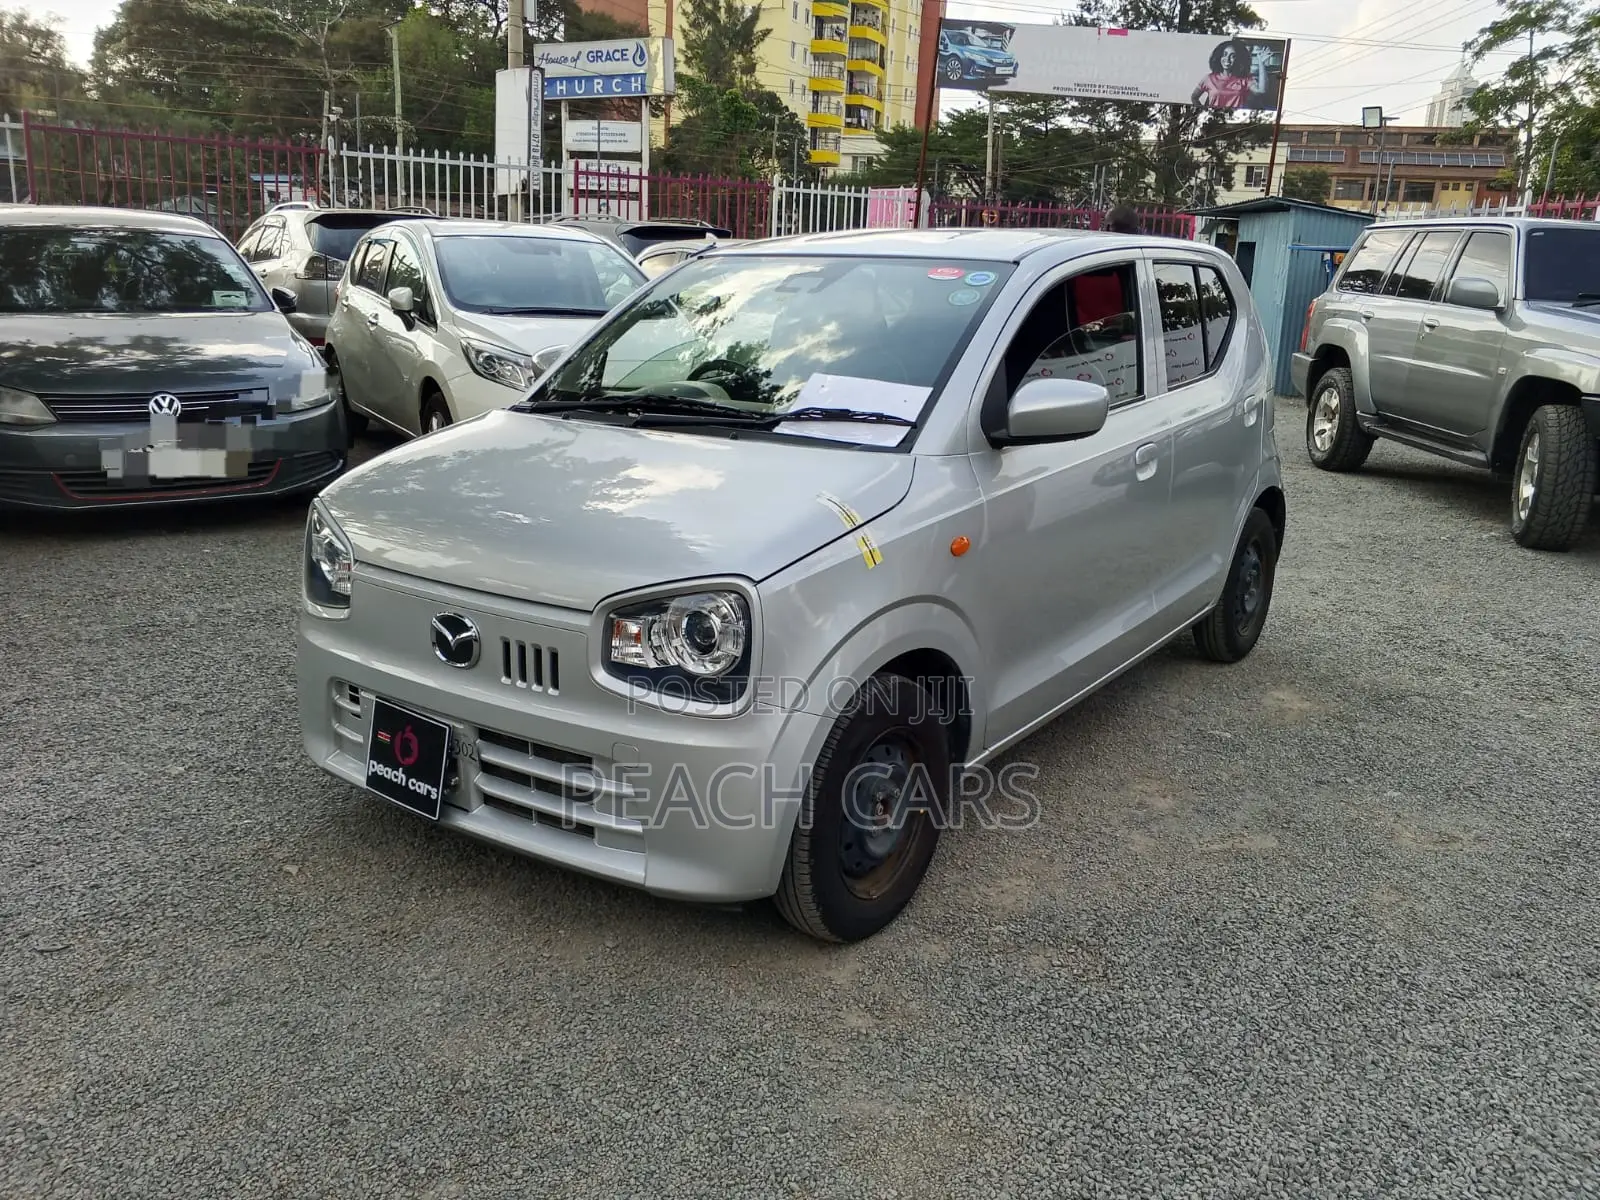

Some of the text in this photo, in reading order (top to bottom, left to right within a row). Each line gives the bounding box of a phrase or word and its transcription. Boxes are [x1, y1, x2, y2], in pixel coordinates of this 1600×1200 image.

[538, 48, 629, 68] House of GRACE
[368, 759, 438, 800] peach cars
